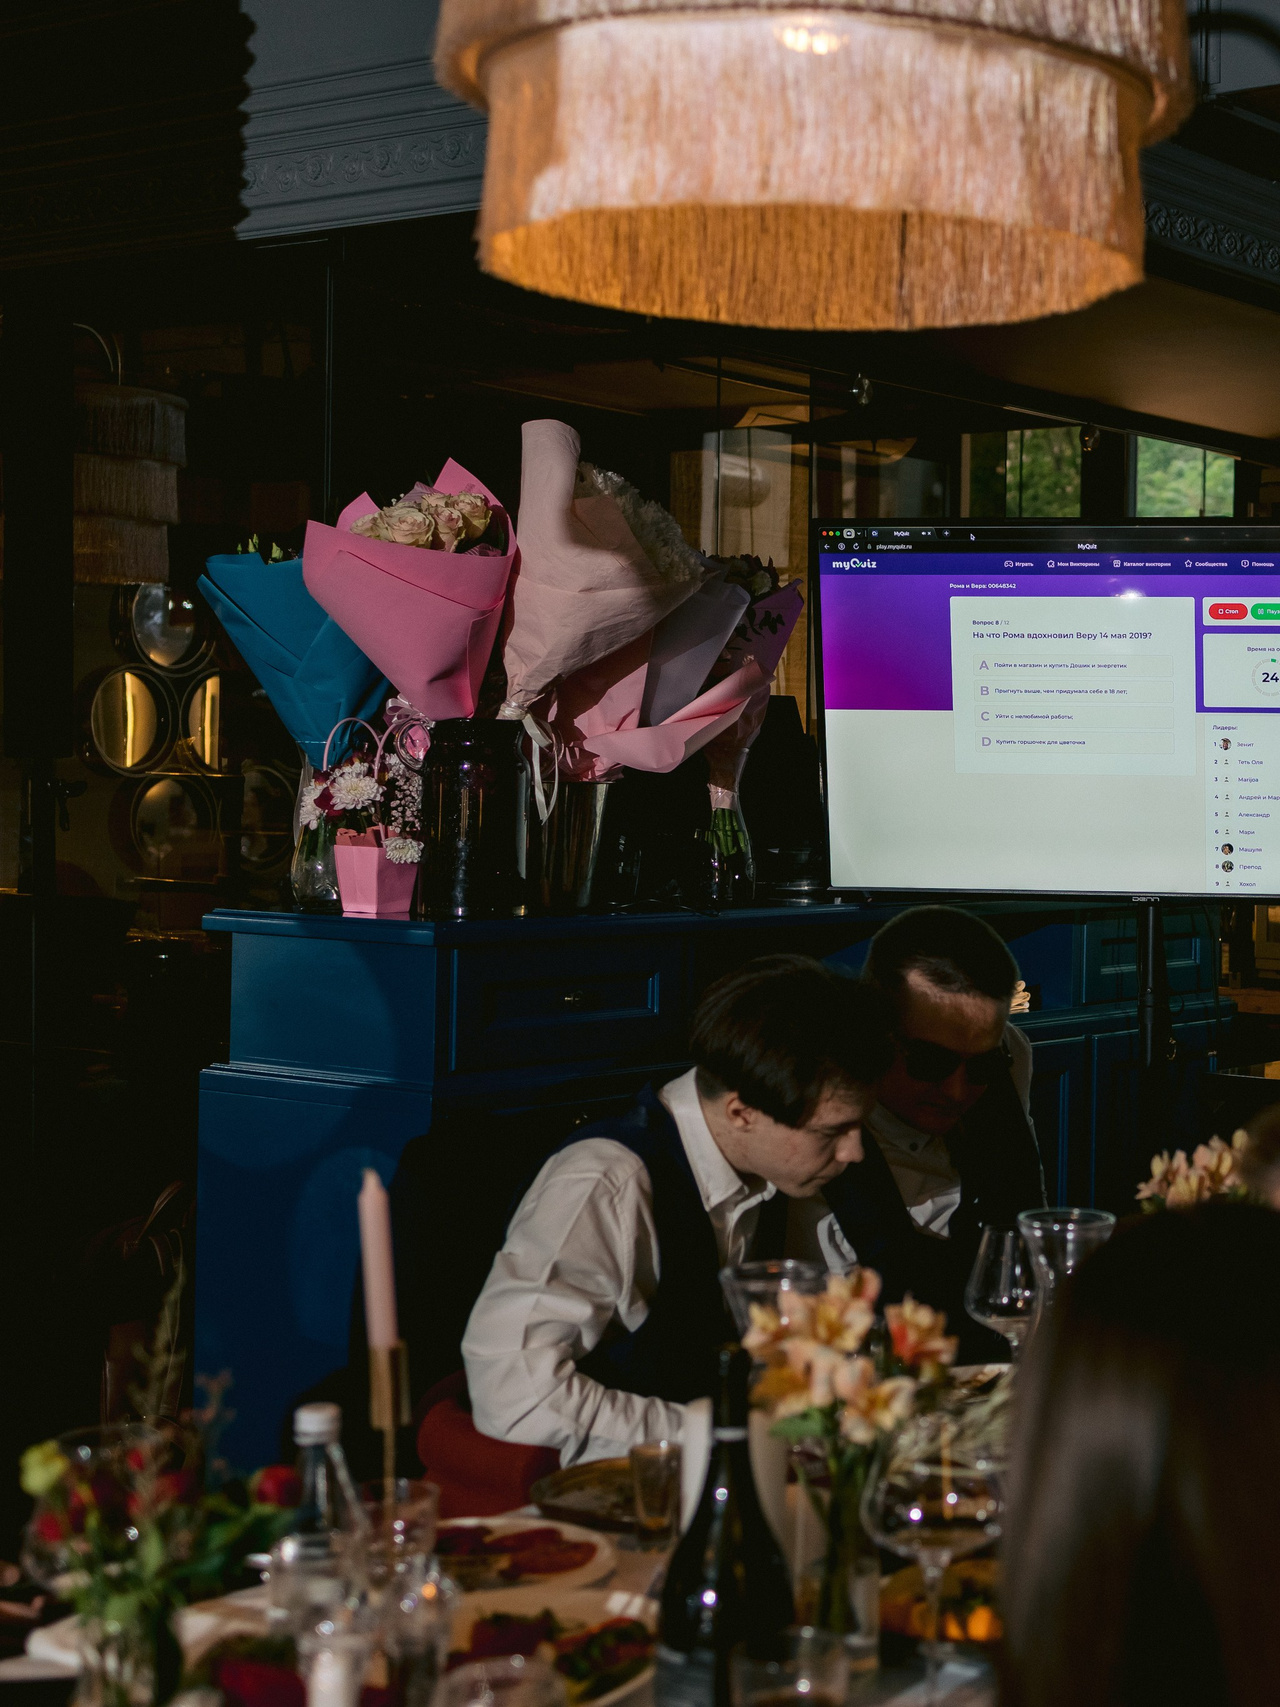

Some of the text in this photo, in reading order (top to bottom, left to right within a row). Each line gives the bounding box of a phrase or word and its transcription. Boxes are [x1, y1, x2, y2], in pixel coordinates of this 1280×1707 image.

[832, 558, 877, 570] myQuiz
[972, 631, 985, 639] На
[1002, 631, 1025, 639] Рома
[1027, 633, 1074, 641] вдохновил
[1076, 631, 1098, 641] Веру
[1129, 632, 1152, 640] 2019?
[979, 660, 990, 671] A
[1262, 672, 1280, 683] 24
[980, 686, 990, 696] B
[980, 711, 990, 721] C
[981, 737, 992, 746] D
